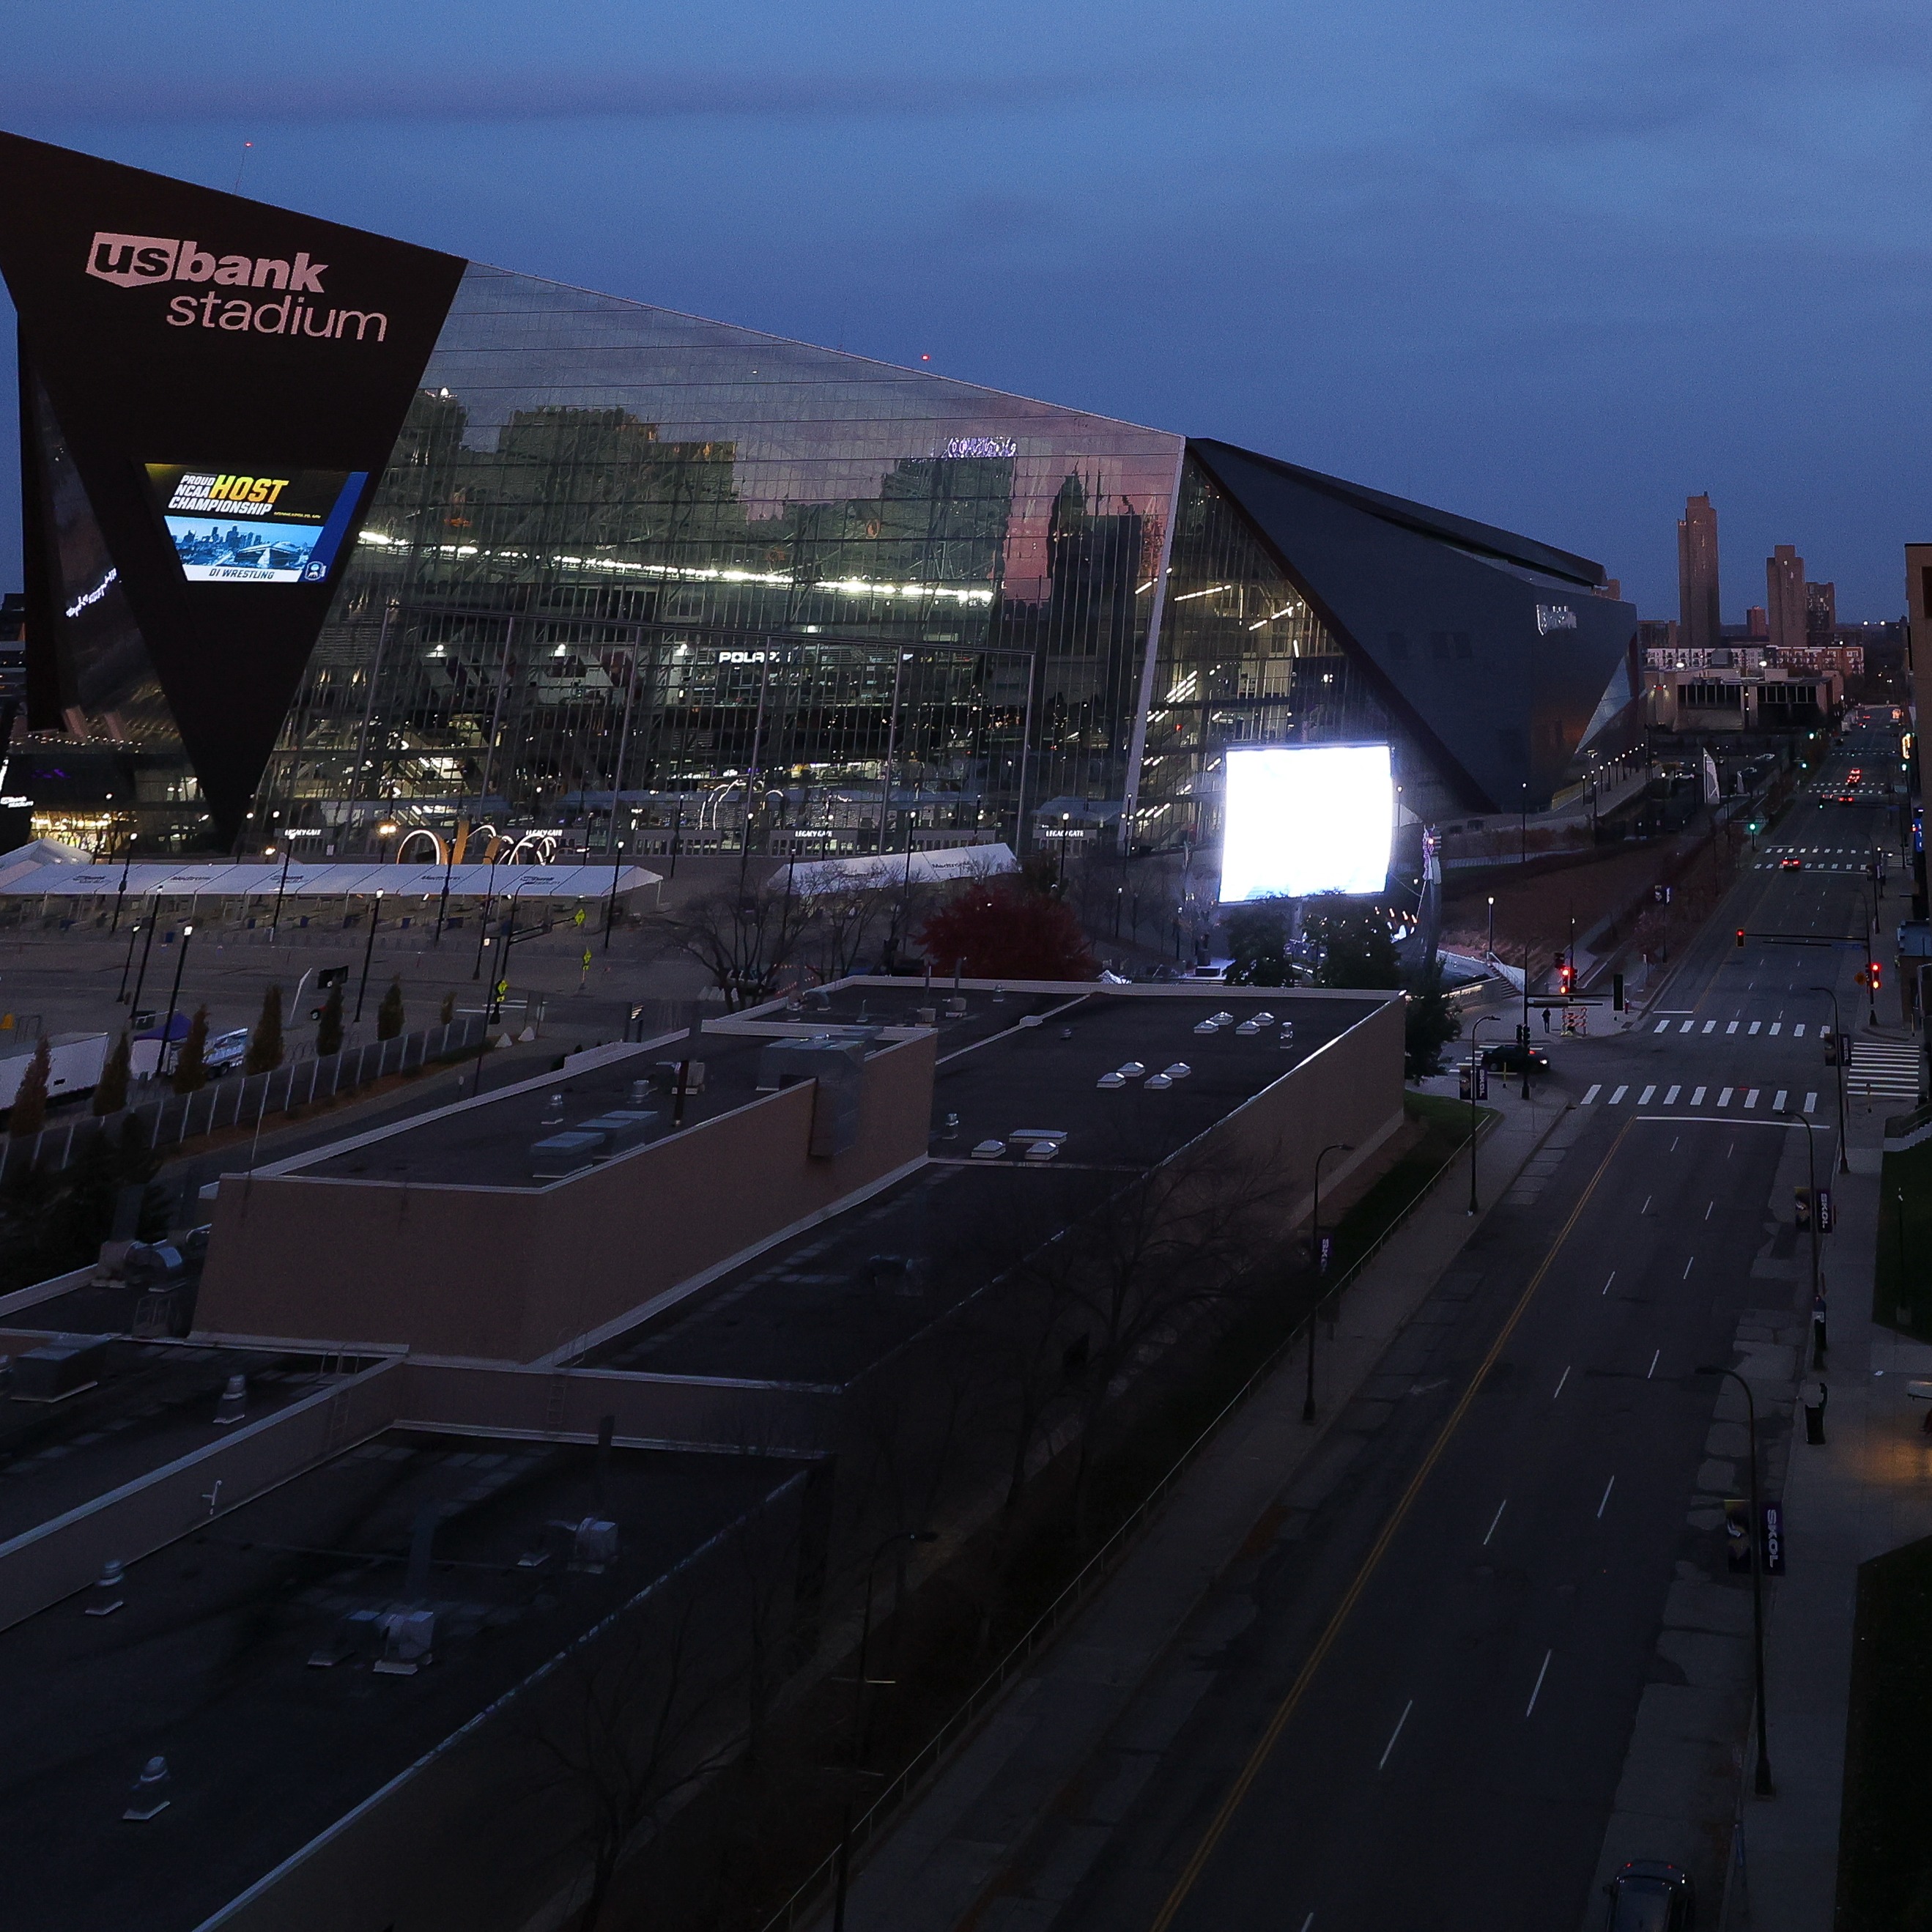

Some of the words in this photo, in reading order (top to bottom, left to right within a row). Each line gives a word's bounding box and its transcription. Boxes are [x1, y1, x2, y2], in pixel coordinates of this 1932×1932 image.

[166, 291, 388, 342] stadium
[174, 484, 212, 498] NCAA
[179, 474, 216, 486] PROUD
[209, 475, 290, 503] HOST
[168, 496, 273, 516] CHAMPIONSHIP
[221, 569, 275, 580] WRESTLING
[1821, 1193, 1829, 1229] SKOL
[1767, 1509, 1779, 1569] SKOL
